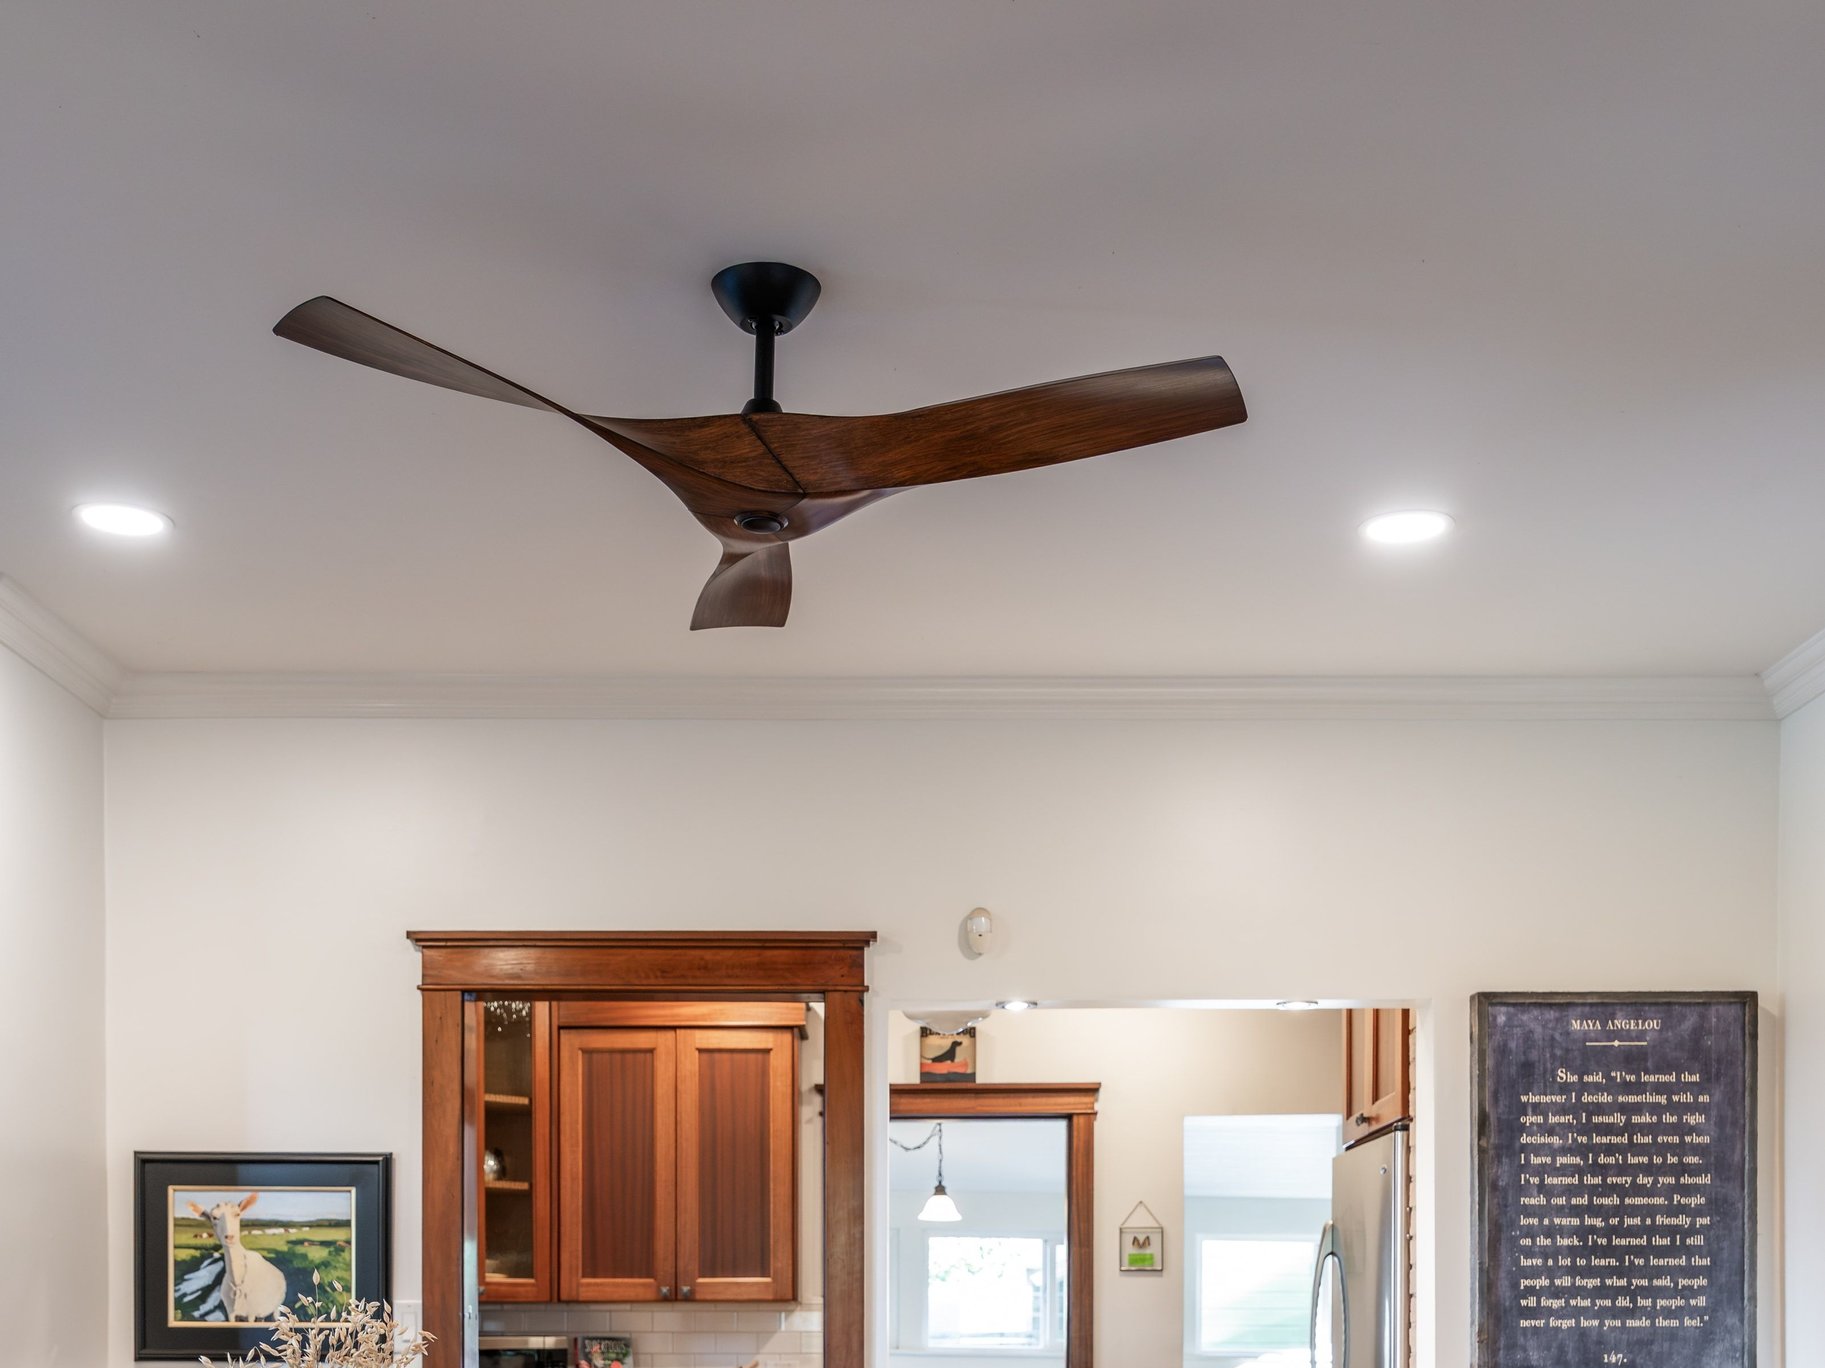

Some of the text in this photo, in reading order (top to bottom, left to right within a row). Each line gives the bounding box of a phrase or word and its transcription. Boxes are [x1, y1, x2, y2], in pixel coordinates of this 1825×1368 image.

[1570, 1018, 1662, 1030] MAYA ANGELOU
[1556, 1067, 1700, 1085] She said, "I've learned that
[1520, 1091, 1710, 1106] whenever I decide something with an
[1519, 1111, 1706, 1127] open heart, I usually make the right
[1519, 1132, 1711, 1145] decision. I've learned that even when
[1520, 1152, 1703, 1168] I have pains, I don't have to be one.
[1520, 1173, 1711, 1188] I've learned that every day you should
[1520, 1193, 1706, 1208] reach out and touch someone. People
[1519, 1213, 1711, 1229] love a warm hug, or just a friendly pat
[1519, 1234, 1704, 1247] on the back. I've learned that I still
[1520, 1254, 1711, 1267] have a lot to learn. I've learned that
[1520, 1275, 1708, 1290] people will forget what you said, people
[1519, 1295, 1706, 1310] will forget what you did, but people will
[1519, 1315, 1709, 1331] never forget how you made them feel."
[1603, 1350, 1628, 1366] 147.
